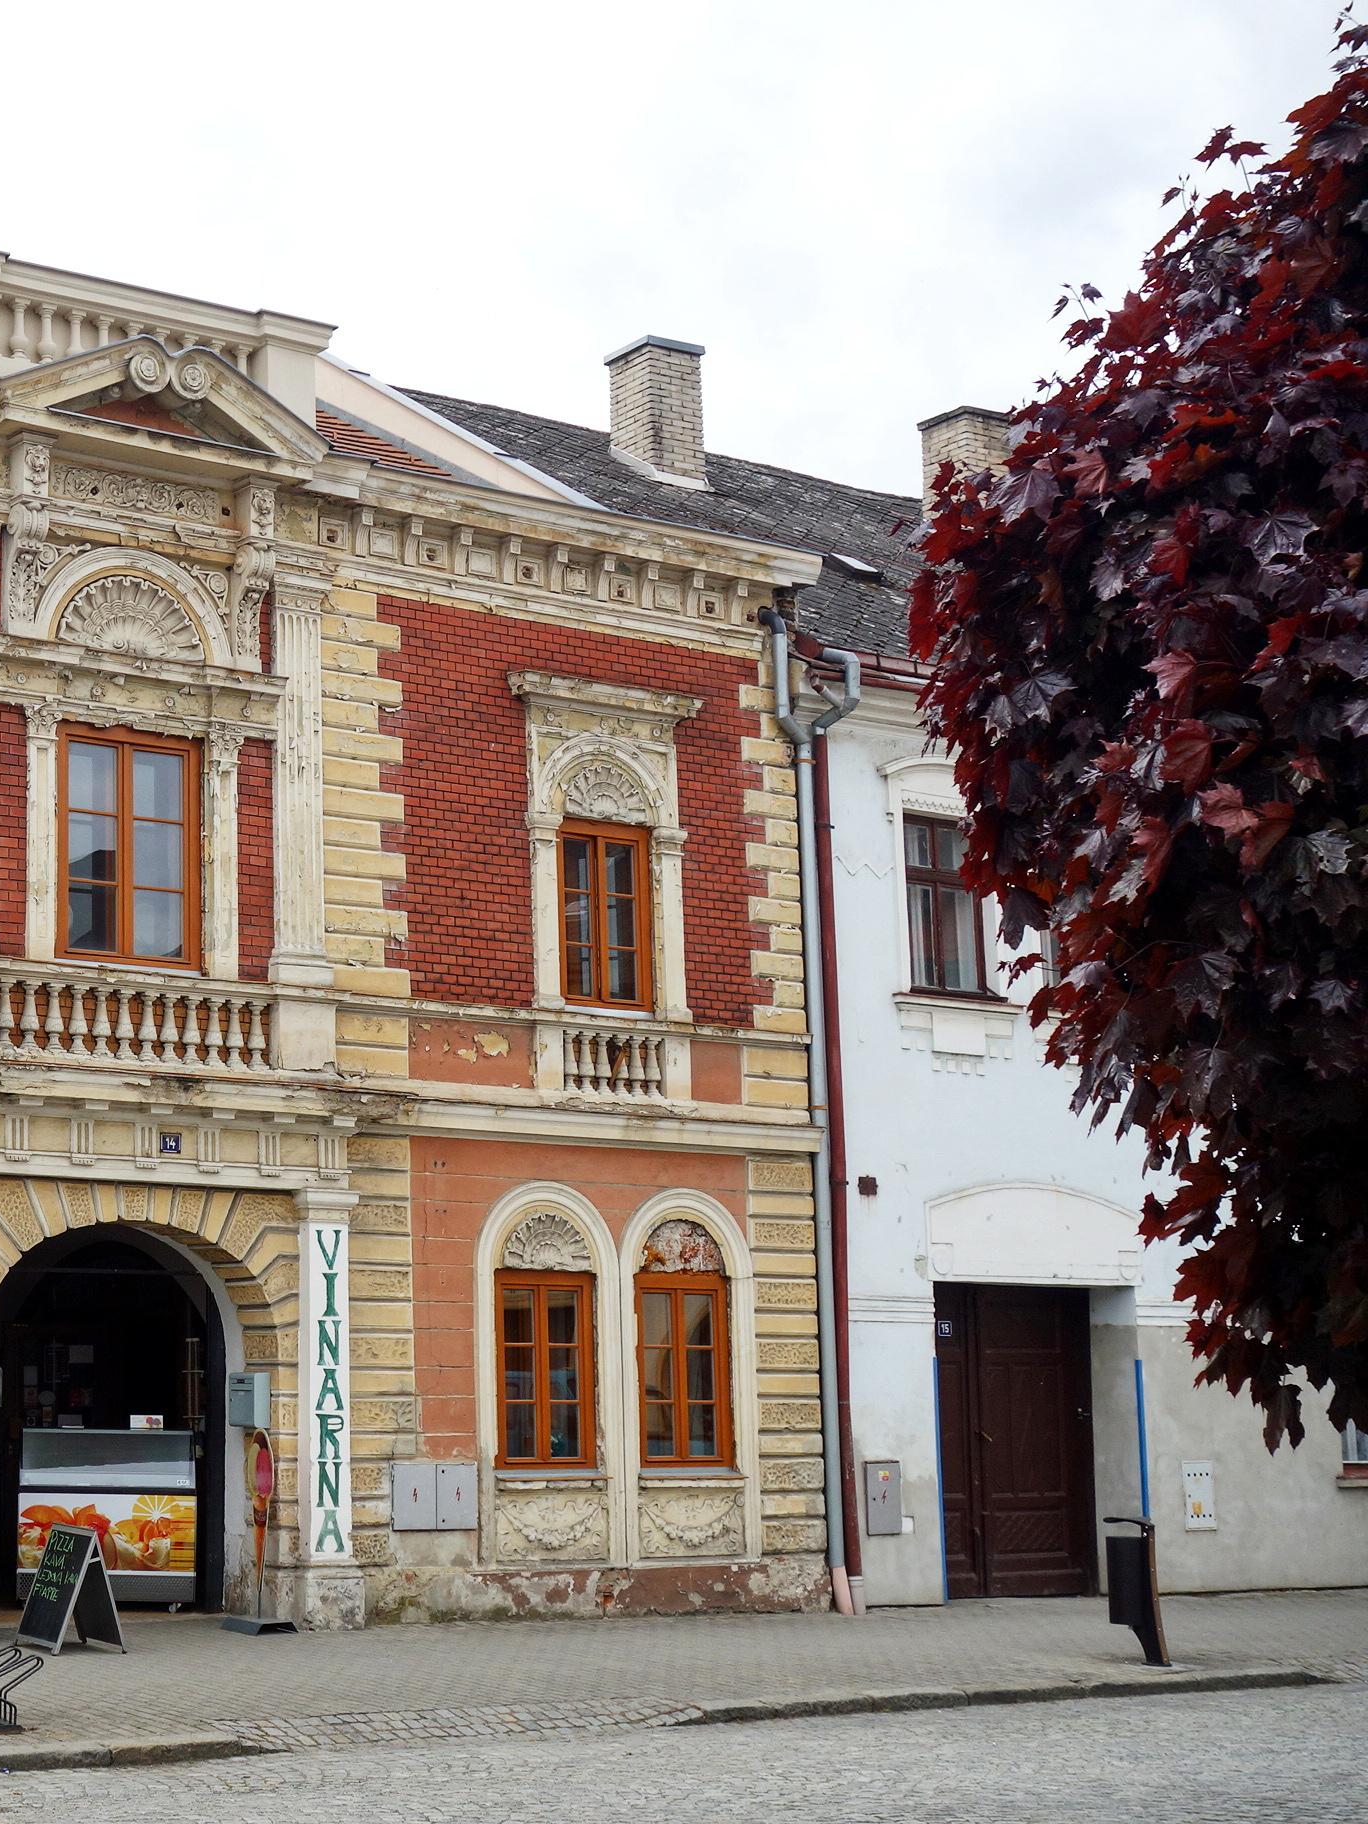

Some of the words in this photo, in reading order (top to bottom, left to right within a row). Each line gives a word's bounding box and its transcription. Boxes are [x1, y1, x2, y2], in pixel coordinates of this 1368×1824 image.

[165, 1136, 177, 1150] 14
[940, 1323, 950, 1334] 15
[315, 1229, 345, 1553] VINARNA
[48, 1530, 75, 1552] PIZZA
